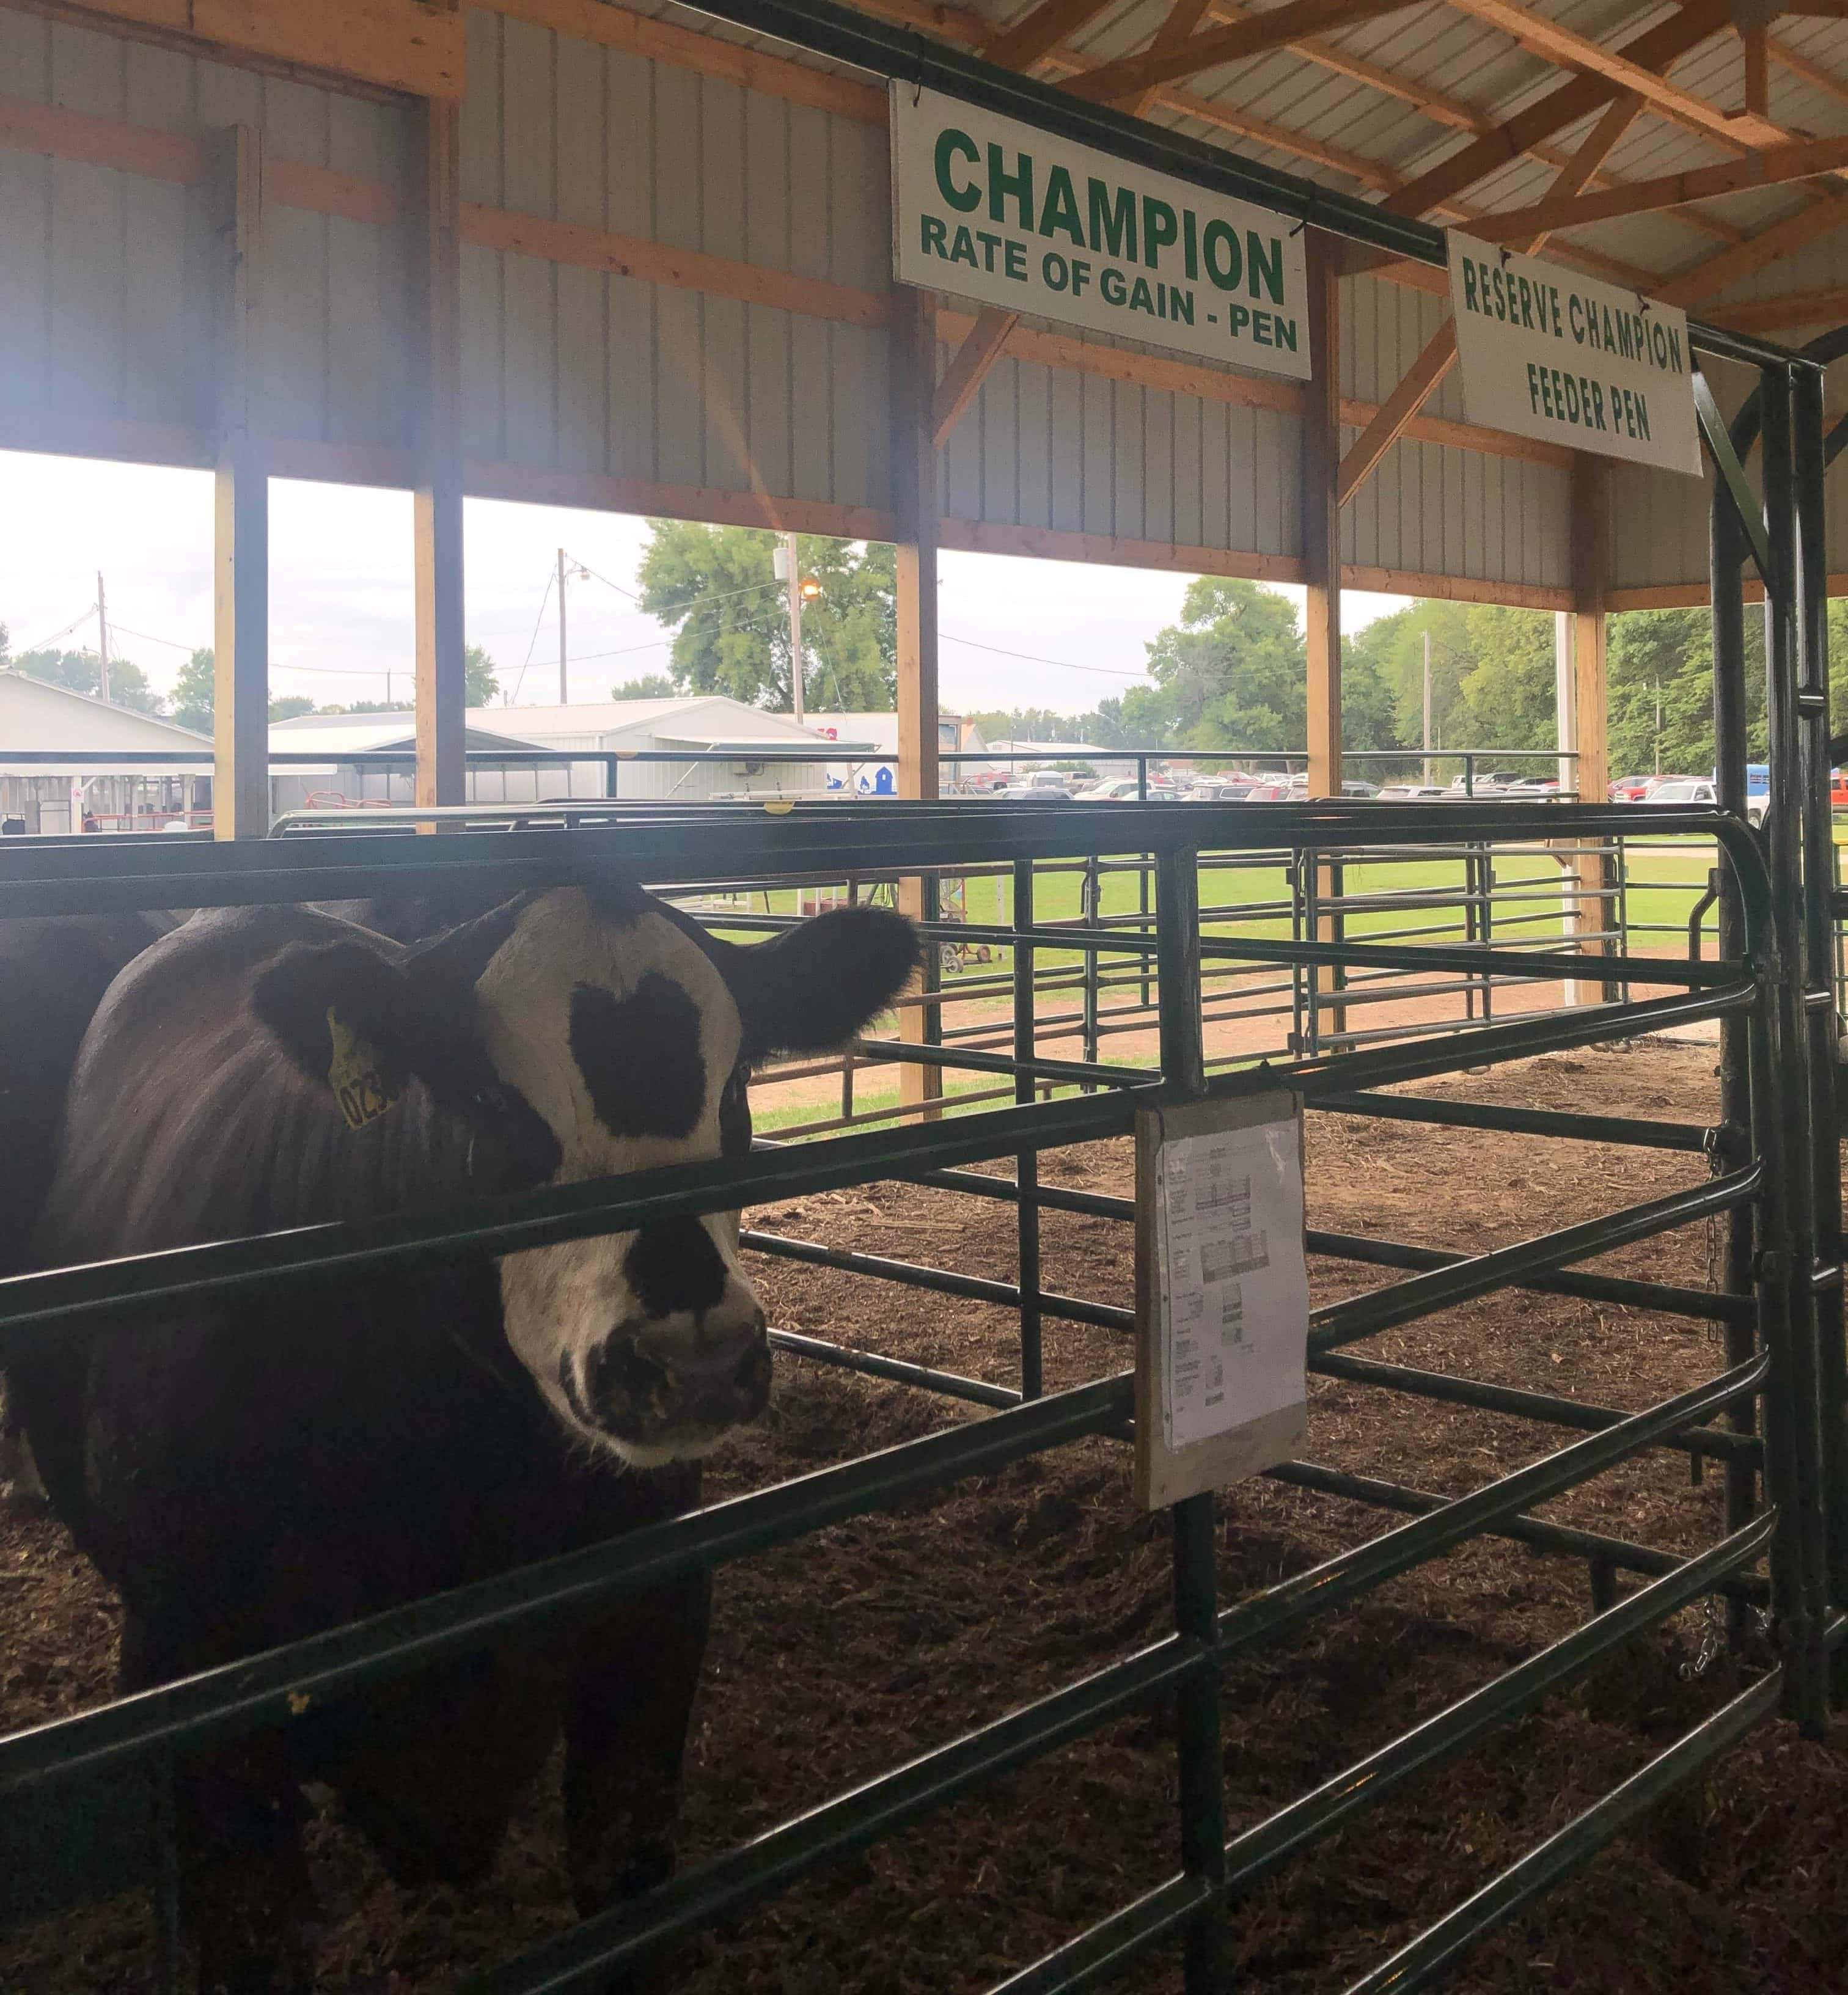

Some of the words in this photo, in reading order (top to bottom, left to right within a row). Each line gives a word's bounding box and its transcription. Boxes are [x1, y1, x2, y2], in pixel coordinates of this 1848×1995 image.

[934, 128, 1285, 306] CHAMPION
[920, 214, 1028, 282] RATE
[1041, 252, 1091, 297] OF
[1100, 268, 1195, 326] GAIN
[1230, 303, 1297, 352] PEN
[1462, 257, 1564, 339] RESERVE
[1568, 293, 1683, 374] CHAMPION
[1527, 362, 1607, 432] FEEDER
[1610, 385, 1651, 442] PEN
